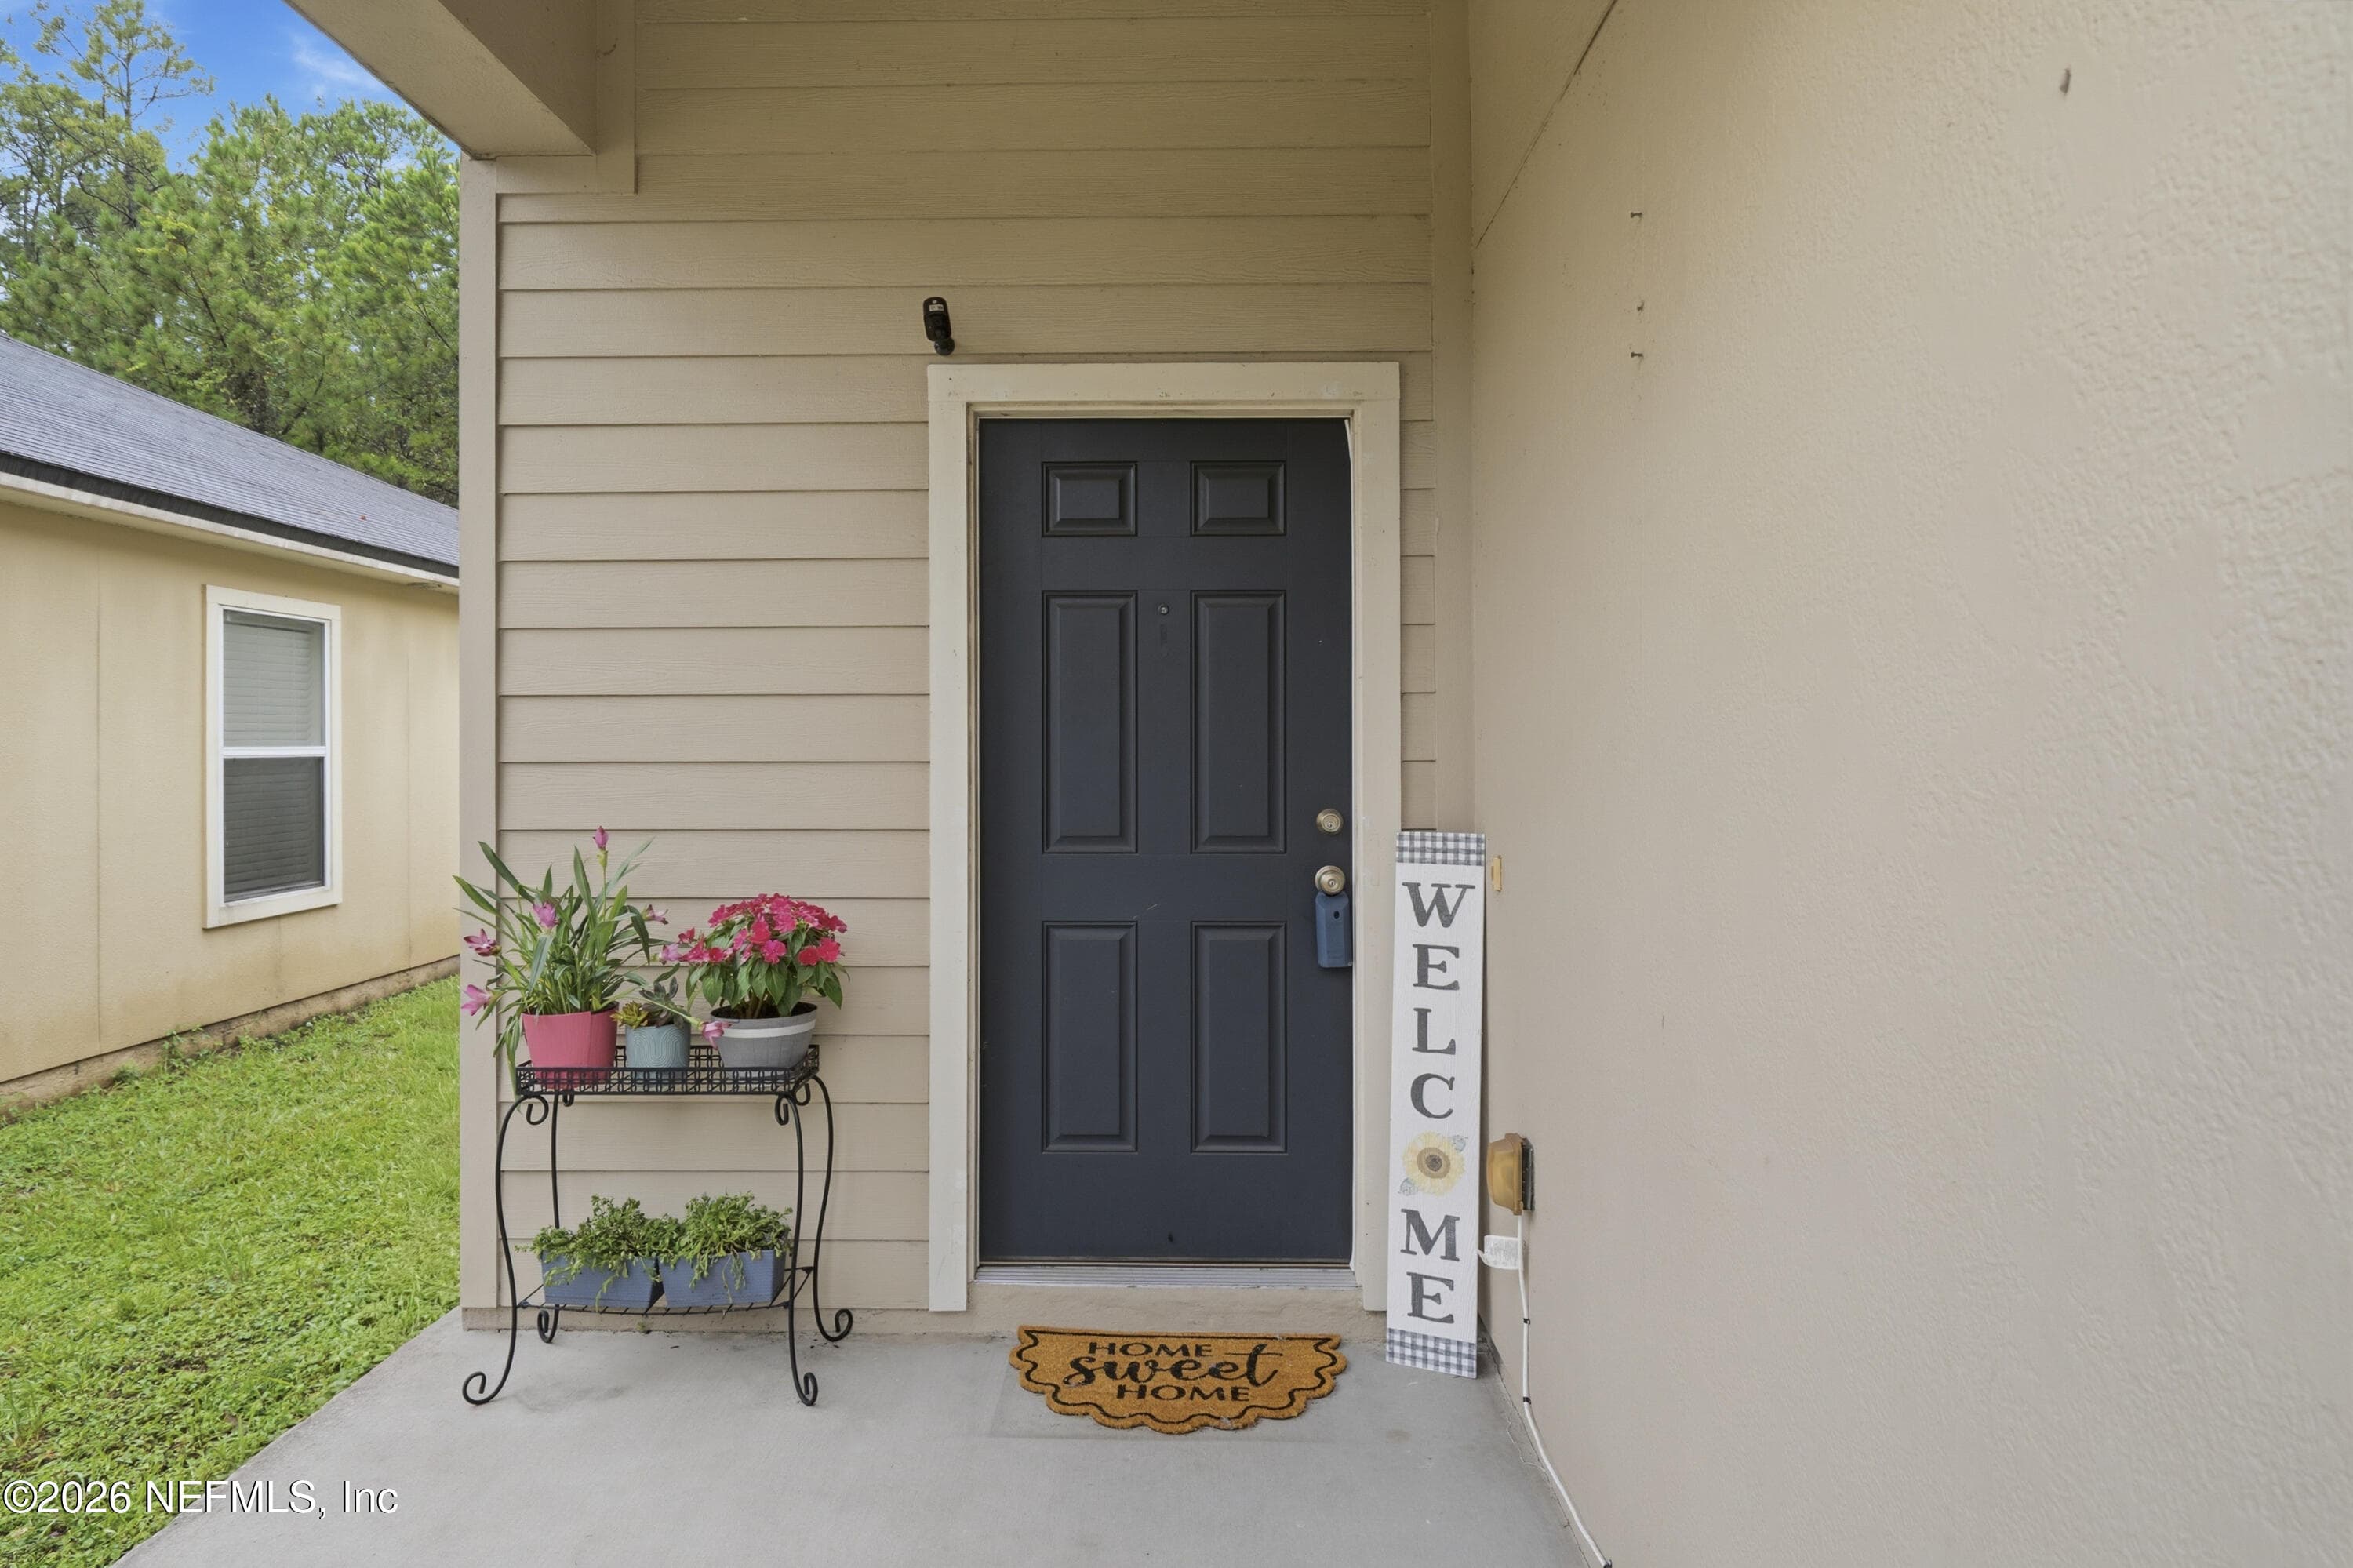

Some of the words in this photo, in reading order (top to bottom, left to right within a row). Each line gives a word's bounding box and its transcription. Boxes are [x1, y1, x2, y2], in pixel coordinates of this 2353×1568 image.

[1399, 882, 1475, 1324] WELCME
[1063, 1343, 1284, 1387] sweet
[1088, 1341, 1213, 1358] HOME
[1116, 1384, 1251, 1402] HOME
